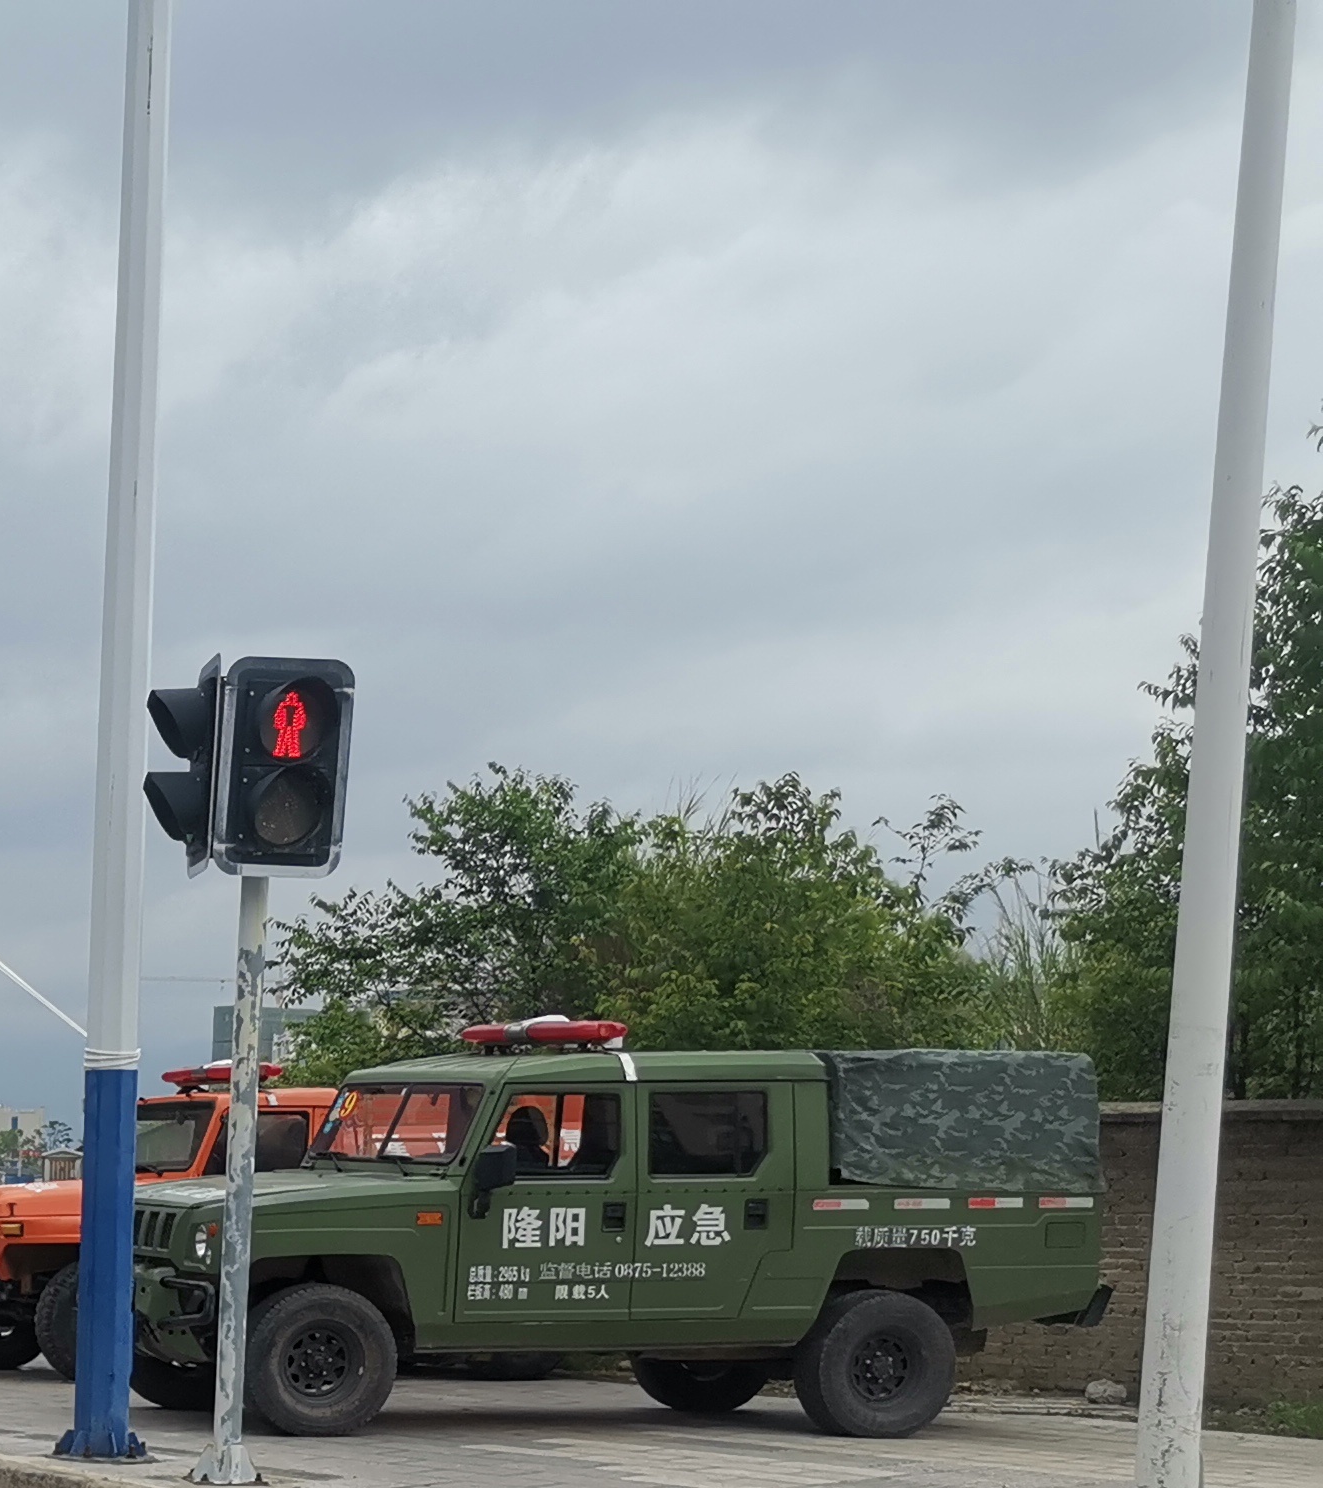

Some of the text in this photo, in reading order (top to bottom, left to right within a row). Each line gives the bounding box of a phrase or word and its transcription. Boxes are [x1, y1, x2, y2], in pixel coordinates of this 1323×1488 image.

[501, 1204, 732, 1249] 隆阳 应急
[855, 1226, 977, 1248] 载质量750千克
